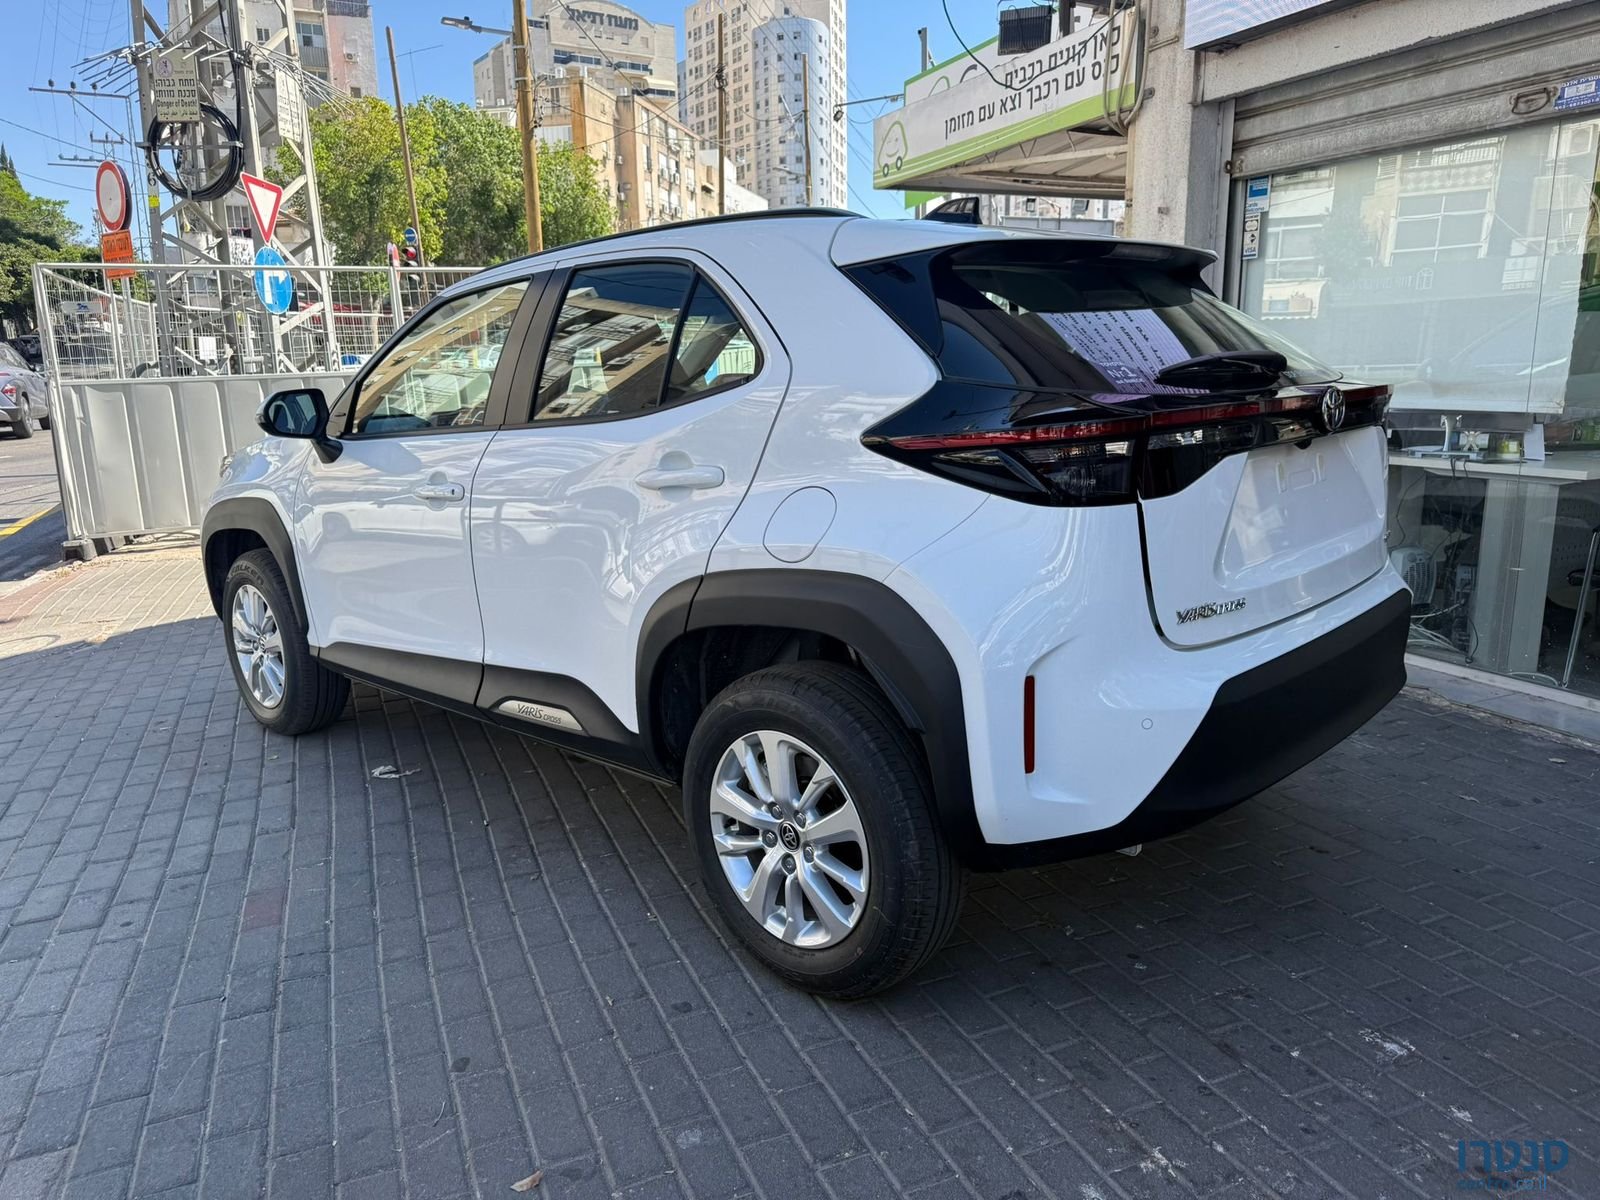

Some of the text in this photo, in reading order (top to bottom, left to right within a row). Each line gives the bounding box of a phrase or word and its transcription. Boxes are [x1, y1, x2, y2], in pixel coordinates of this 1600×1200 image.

[1048, 39, 1088, 69] קונים
[178, 78, 195, 87] מתח
[1005, 59, 1043, 89] רכבים
[944, 53, 1120, 140] כס עם רכבך וצא עם מזומן
[517, 703, 543, 719] YARIS
